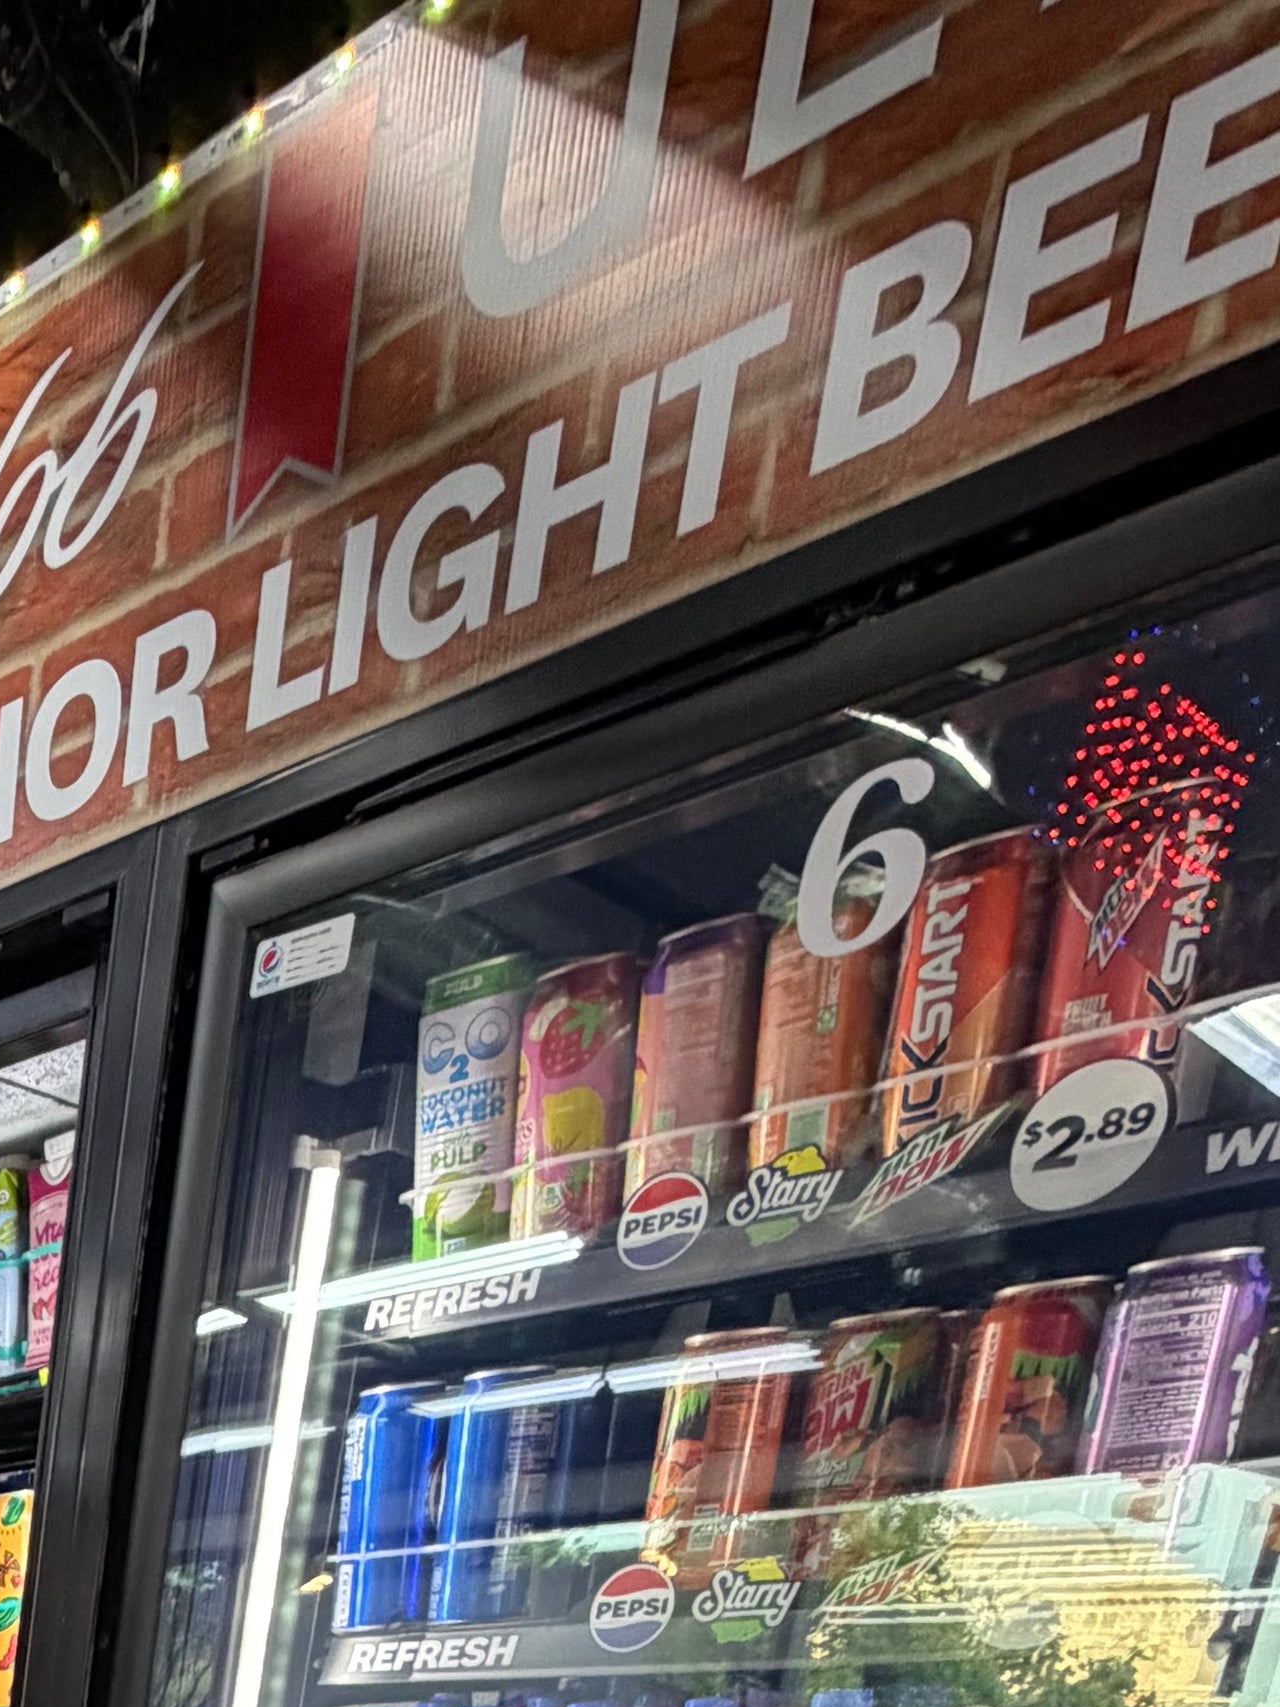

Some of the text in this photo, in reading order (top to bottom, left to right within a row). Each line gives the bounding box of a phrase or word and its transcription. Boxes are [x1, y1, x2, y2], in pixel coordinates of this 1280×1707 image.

[246, 303, 791, 733] LIGHT
[797, 757, 935, 958] 6
[419, 1097, 508, 1135] WATER
[421, 1076, 509, 1110] COCONUT
[1021, 1101, 1156, 1174] $2.89
[429, 1141, 488, 1172] PULP
[364, 1164, 844, 1334] REFRESH PEPSI Starry
[347, 1636, 519, 1674] REFRESH
[594, 1596, 669, 1622] PEPSI
[692, 1569, 801, 1627] Starry
